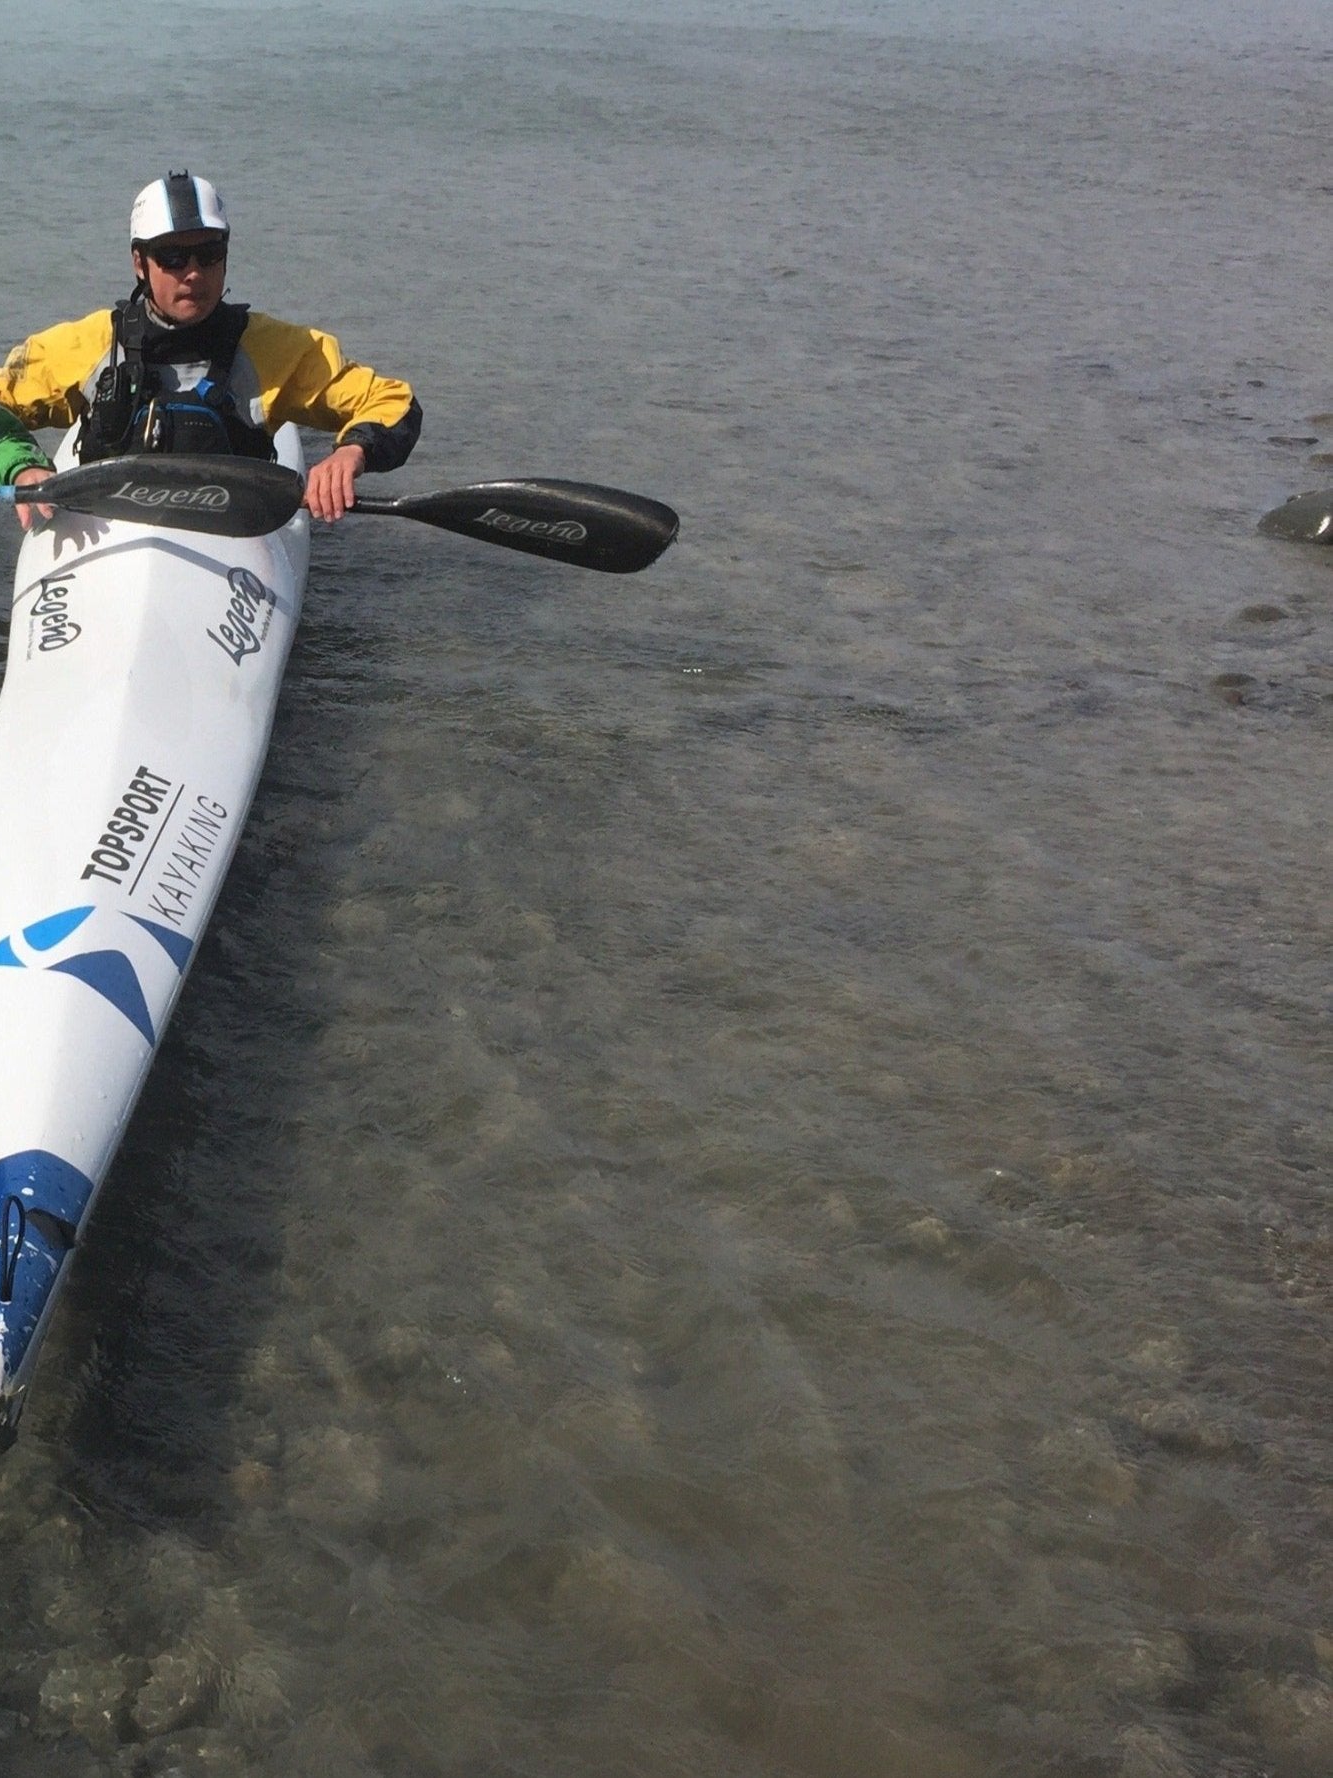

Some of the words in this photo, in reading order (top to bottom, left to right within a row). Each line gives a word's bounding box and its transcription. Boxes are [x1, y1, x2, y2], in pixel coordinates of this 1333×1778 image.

[108, 481, 230, 507] Legend
[473, 508, 587, 540] Legend
[31, 573, 82, 652] Legend
[206, 567, 267, 666] Legend
[80, 765, 172, 885] TOPSPORT
[148, 795, 228, 926] KAYAKING
